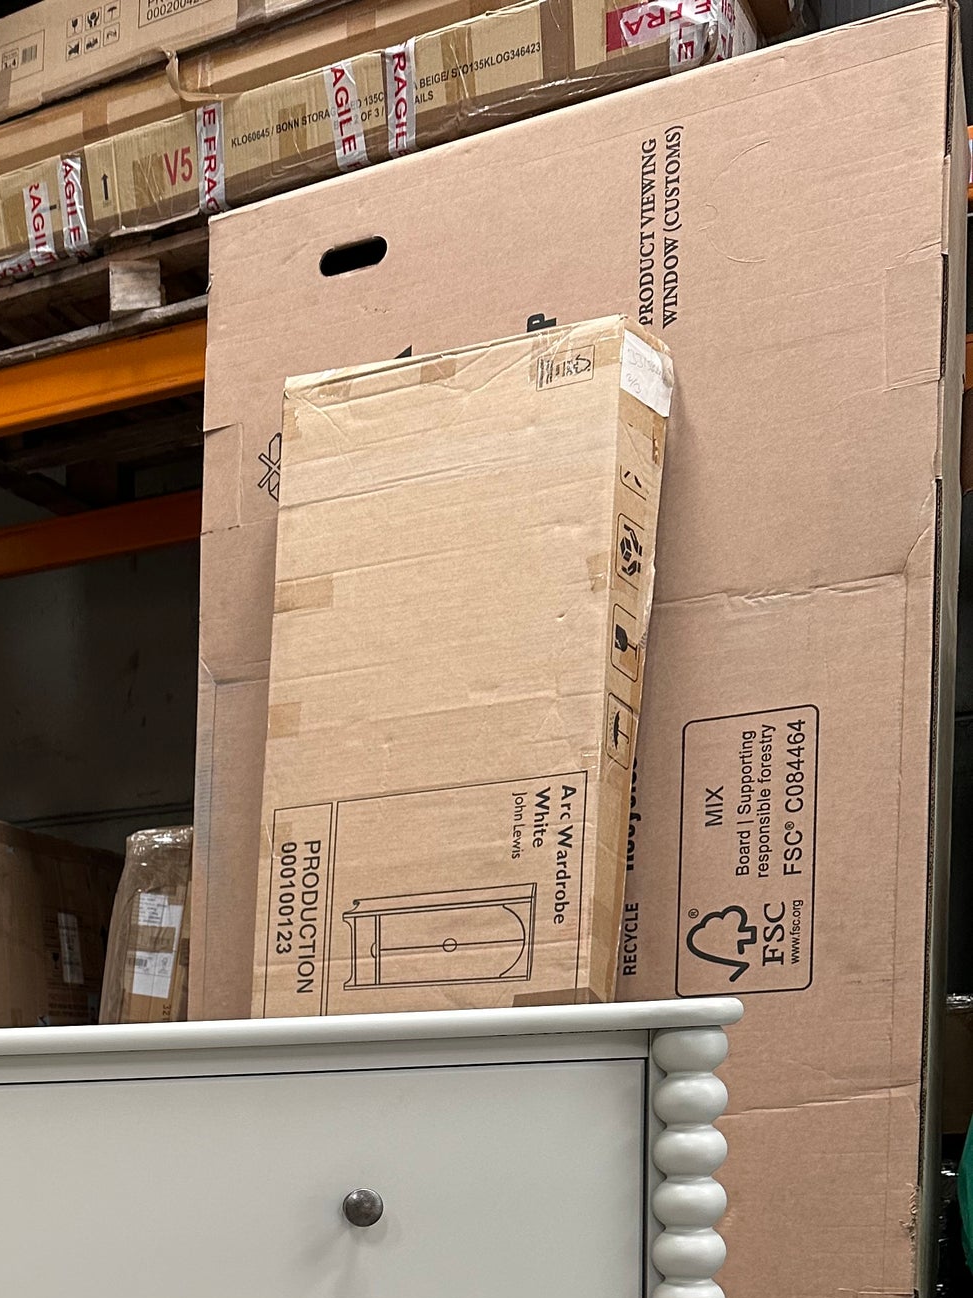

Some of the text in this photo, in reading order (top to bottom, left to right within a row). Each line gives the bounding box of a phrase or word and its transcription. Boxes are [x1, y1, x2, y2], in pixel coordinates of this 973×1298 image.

[275, 116, 300, 134] BONN
[360, 110, 373, 122] OF
[163, 146, 194, 187] V5
[638, 137, 657, 326] PRODUCT VIEWING
[662, 125, 684, 330] WINDOW (CUSTOMS)
[736, 729, 757, 816] Supporting
[757, 723, 777, 878] responsible forestry
[784, 718, 806, 814] C084464
[511, 791, 528, 860] John Lewis
[531, 786, 552, 849] White
[704, 785, 725, 828] MIX
[552, 784, 578, 926] Arc Wardrobe
[735, 829, 751, 877] Board
[275, 841, 298, 955] 000100123
[295, 839, 322, 995] PRODUCTION
[762, 900, 786, 967] FSC
[790, 899, 804, 965] www.fsc.org
[622, 901, 640, 977] RECYCLE
